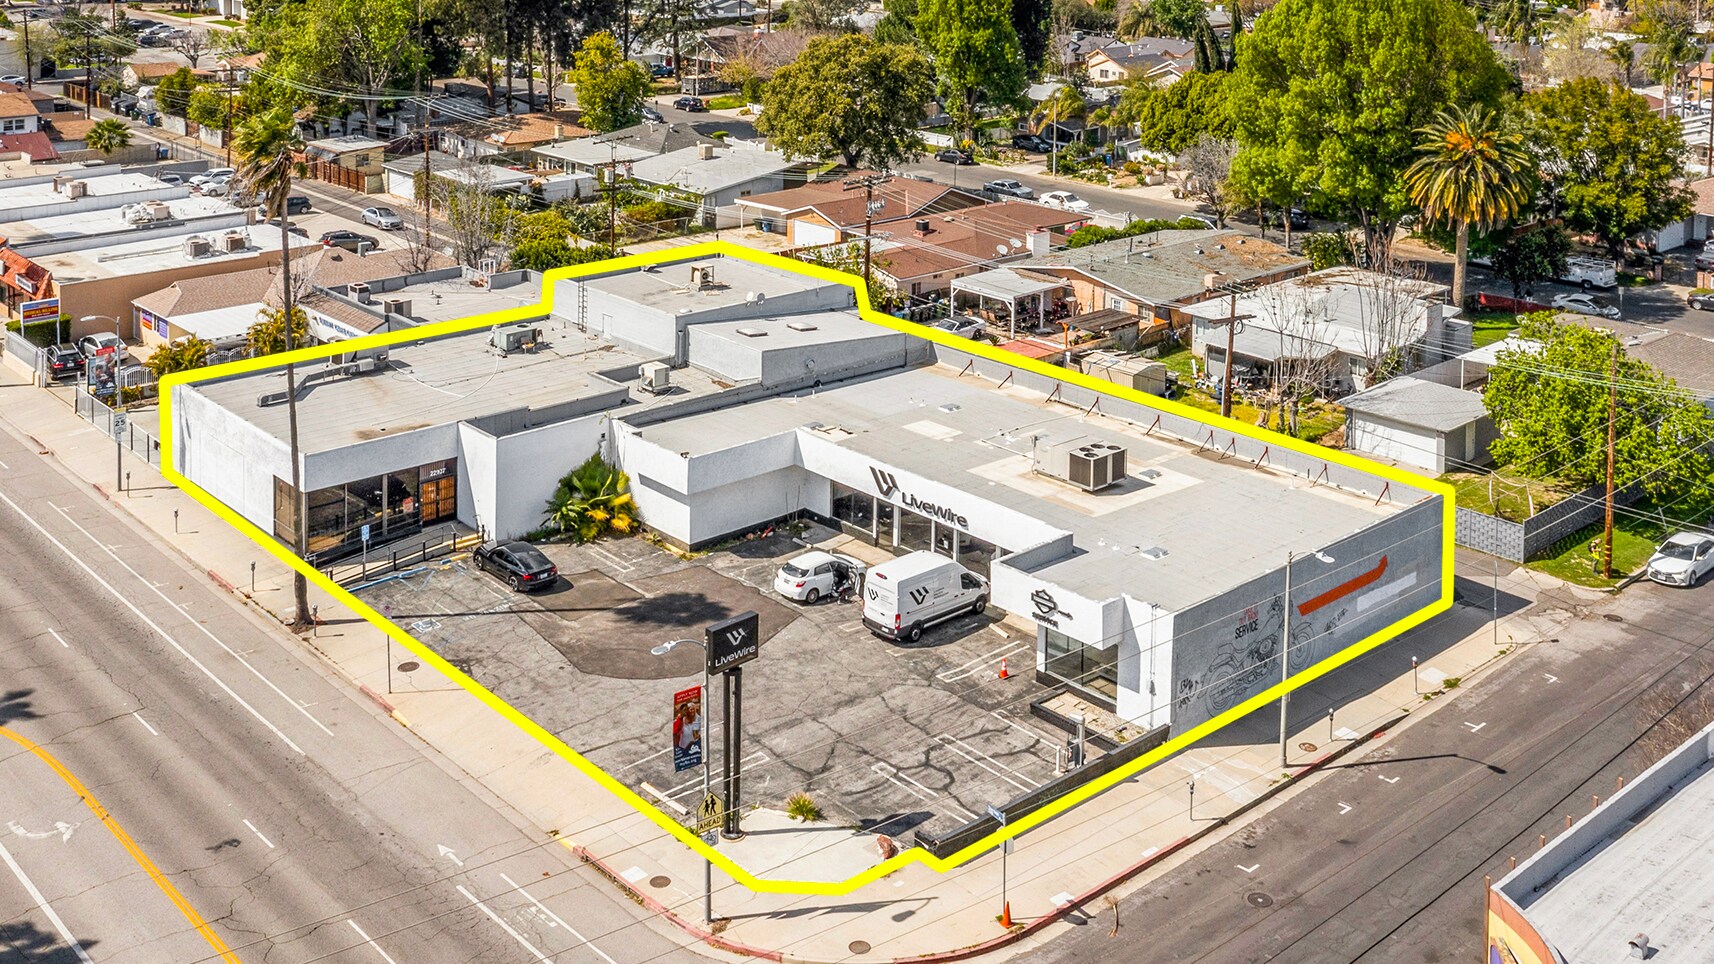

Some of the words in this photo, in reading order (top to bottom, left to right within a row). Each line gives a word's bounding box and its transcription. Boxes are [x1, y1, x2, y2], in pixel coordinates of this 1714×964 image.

[902, 492, 968, 527] LiveWire
[1235, 619, 1258, 639] SERVICE
[715, 645, 756, 667] LiveWire
[699, 816, 721, 831] AHEAD
